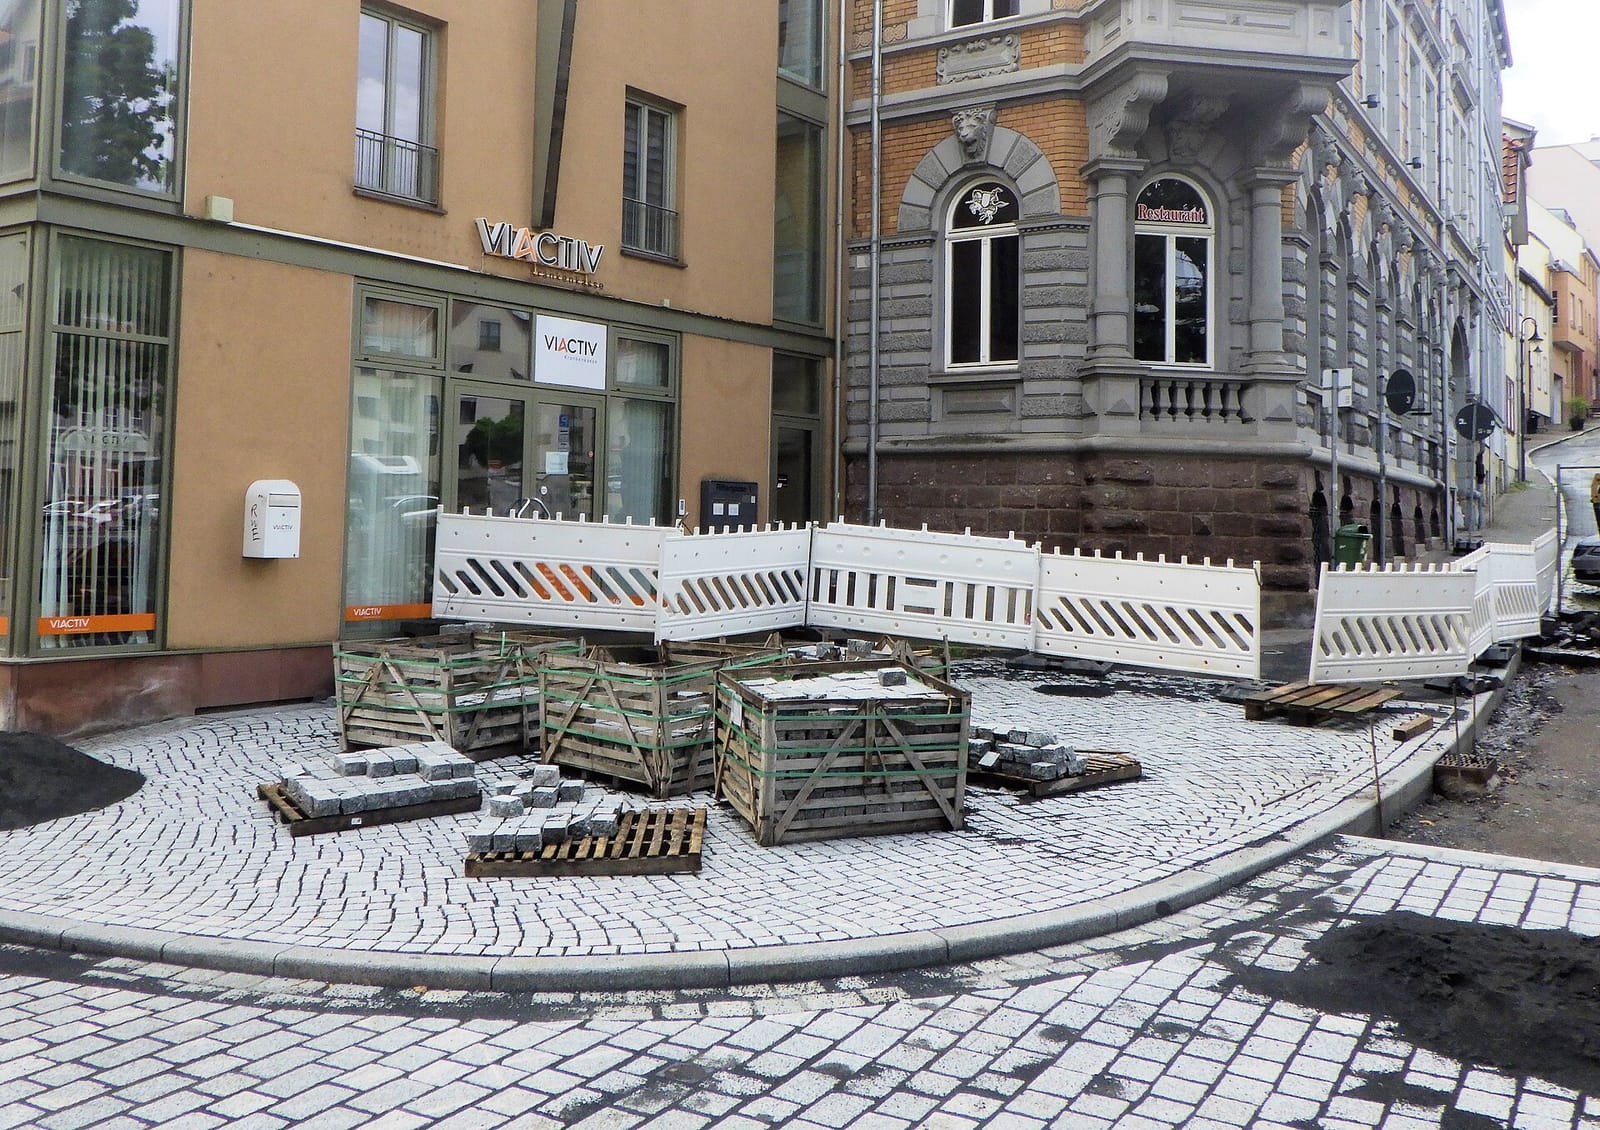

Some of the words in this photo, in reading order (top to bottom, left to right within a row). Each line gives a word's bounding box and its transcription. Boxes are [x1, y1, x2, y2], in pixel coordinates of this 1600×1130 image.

[1137, 204, 1204, 223] Restaurant
[476, 217, 604, 274] VIACTIV
[544, 334, 598, 357] VIACTIV
[353, 607, 382, 616] VIACTIV
[50, 618, 90, 629] VIACTIV
